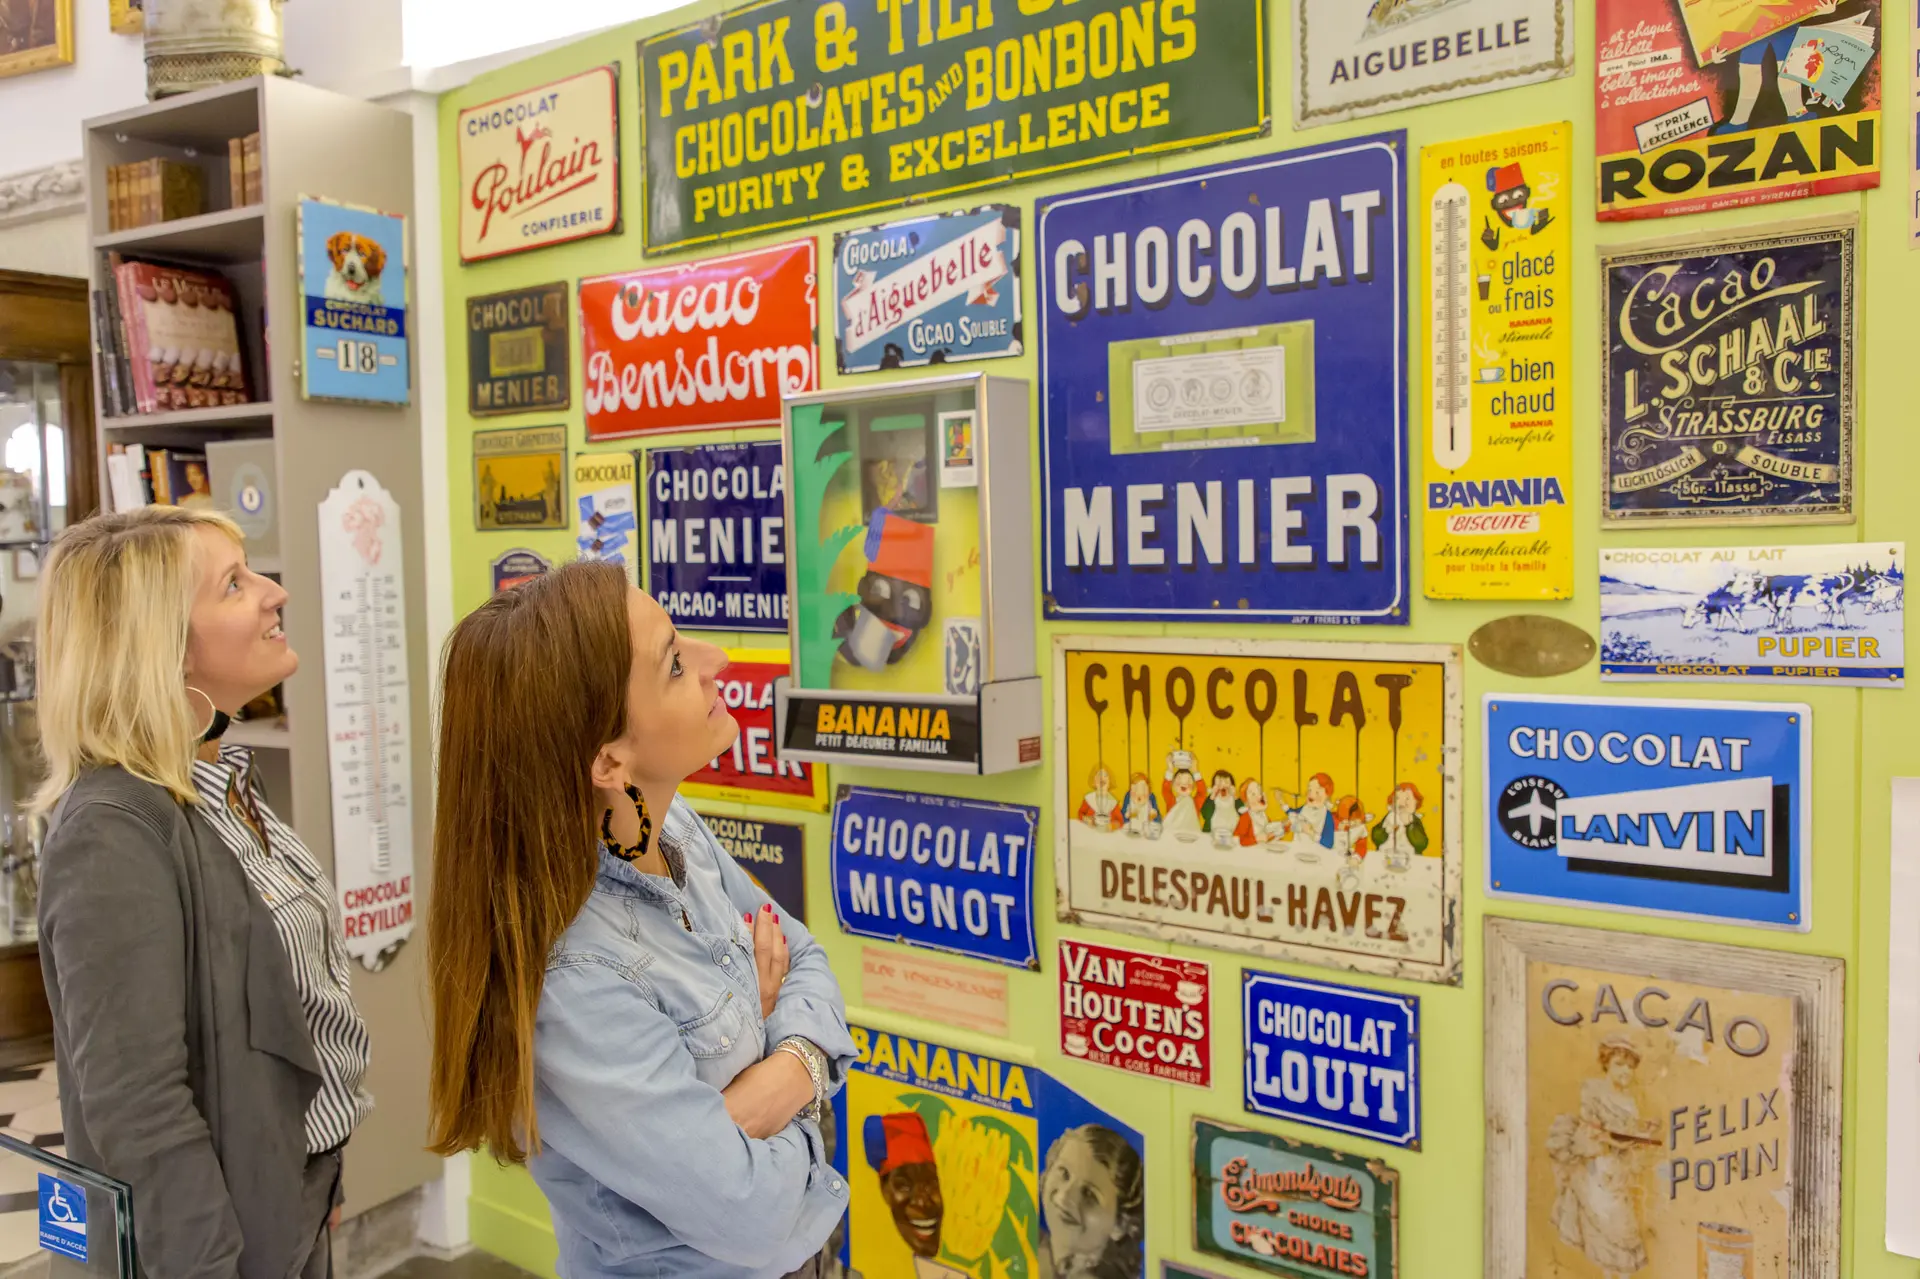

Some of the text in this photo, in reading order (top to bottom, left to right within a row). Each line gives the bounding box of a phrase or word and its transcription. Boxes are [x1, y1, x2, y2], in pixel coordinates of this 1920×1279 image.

[658, 16, 794, 117] PARK
[814, 1, 858, 73] &
[1329, 18, 1530, 85] AIGUEBELLE
[1822, 45, 1856, 71] Rozan
[675, 0, 1196, 179] CHOCOLATES AND BONBONS
[1599, 66, 1684, 93] belle image
[1614, 80, 1701, 106] collectionner
[467, 93, 559, 136] CHOCOLAT
[694, 82, 1170, 223] PURITY & EXCELLENCE
[1440, 155, 1454, 170] en
[1459, 147, 1498, 166] toutes
[1600, 118, 1874, 204] ROZAN
[472, 137, 602, 243] Poulain
[521, 207, 603, 237] CONFISERIE
[842, 233, 917, 275] CHOCOLA
[1054, 189, 1382, 316] CHOCOLAT
[1502, 250, 1555, 285] glacé
[855, 237, 993, 338] d'Aiguebelle
[1488, 285, 1554, 314] ou frais
[1620, 257, 1780, 355] Cacao
[314, 309, 398, 335] SUCHARD
[471, 293, 562, 331] CHOCOLT
[611, 276, 763, 341] Cacao
[1509, 317, 1553, 328] BANANIA
[908, 316, 1007, 354] CACAO SOLUBLE
[1660, 293, 1827, 400] SCHAAL
[585, 336, 811, 415] Bensdorp
[1510, 358, 1555, 384] bien
[1743, 366, 1765, 396] &
[477, 375, 559, 407] MENIER
[1490, 387, 1555, 416] chaud
[1509, 420, 1553, 429] BANANIA
[1767, 430, 1822, 445] ELSASS
[575, 463, 632, 483] CHOCOLAT
[655, 464, 785, 502] CHOCOLA
[1750, 454, 1822, 480] SOLUBLE
[1428, 477, 1566, 509] BANANIA
[1063, 472, 1380, 567] MENIER
[652, 516, 785, 564] MENIE
[1613, 549, 1786, 564] CHOCOLAT AU LAIT
[1500, 561, 1509, 572] la
[1757, 636, 1881, 659] PUPIER
[1656, 664, 1841, 677] CHOCOLAT PUPIER
[1084, 663, 1413, 733] CHOCOLAT
[816, 703, 951, 740] BANANIA
[815, 733, 842, 747] PETIT
[900, 738, 948, 755] FAMILIAL
[1508, 726, 1751, 771] CHOCOLAT
[1507, 778, 1564, 799] L'OISEAU
[842, 813, 1025, 878] CHOCOLAT
[1512, 830, 1556, 848] BLANC
[1561, 809, 1766, 857] LANVIN
[344, 875, 411, 909] CHOCOLAT
[849, 870, 1016, 941] MIGNOT
[1100, 859, 1409, 942] DELESPAUL-HAVEZ
[1061, 944, 1125, 988] VAN
[1063, 981, 1204, 1041] HOUTEN'S
[1258, 998, 1397, 1058] CHOCOLAT
[1541, 978, 1770, 1057] CACAO
[1092, 1022, 1203, 1069] COCOA
[850, 1026, 1034, 1109] BANANIA
[1125, 1059, 1150, 1073] GOES
[1154, 1064, 1202, 1083] FARTHEST
[1252, 1042, 1406, 1124] LOUIT
[1670, 1087, 1779, 1151] FÉLIX
[1670, 1138, 1779, 1200] POTIN
[40, 1231, 60, 1244] RAMPE
[1287, 1209, 1352, 1239] CHOICE
